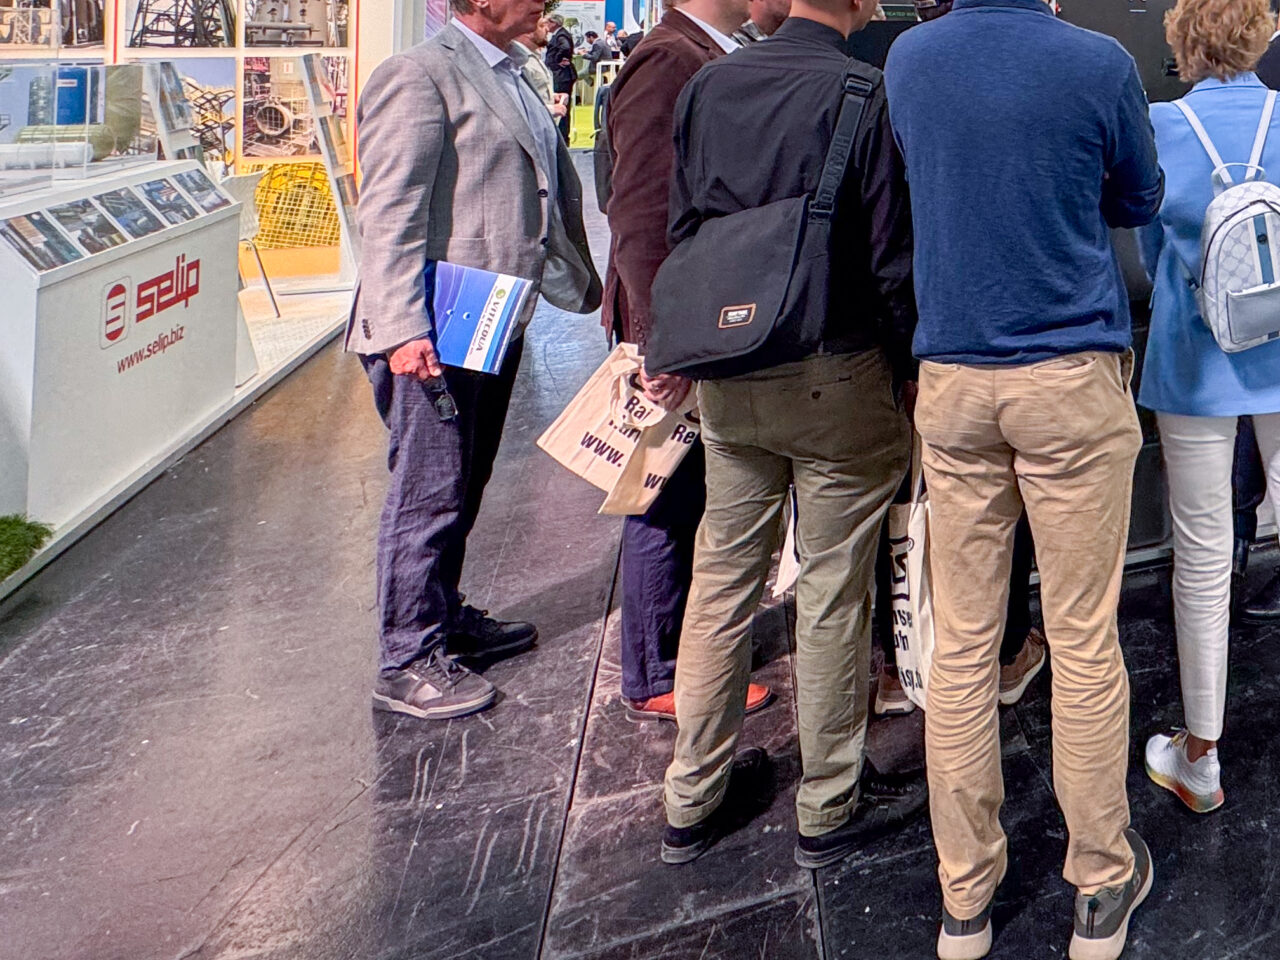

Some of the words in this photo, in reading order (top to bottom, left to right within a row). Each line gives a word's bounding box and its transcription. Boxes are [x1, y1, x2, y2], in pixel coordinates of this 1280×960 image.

[135, 253, 201, 323] selip
[117, 324, 185, 374] www.selip.biz
[580, 431, 625, 468] www.
